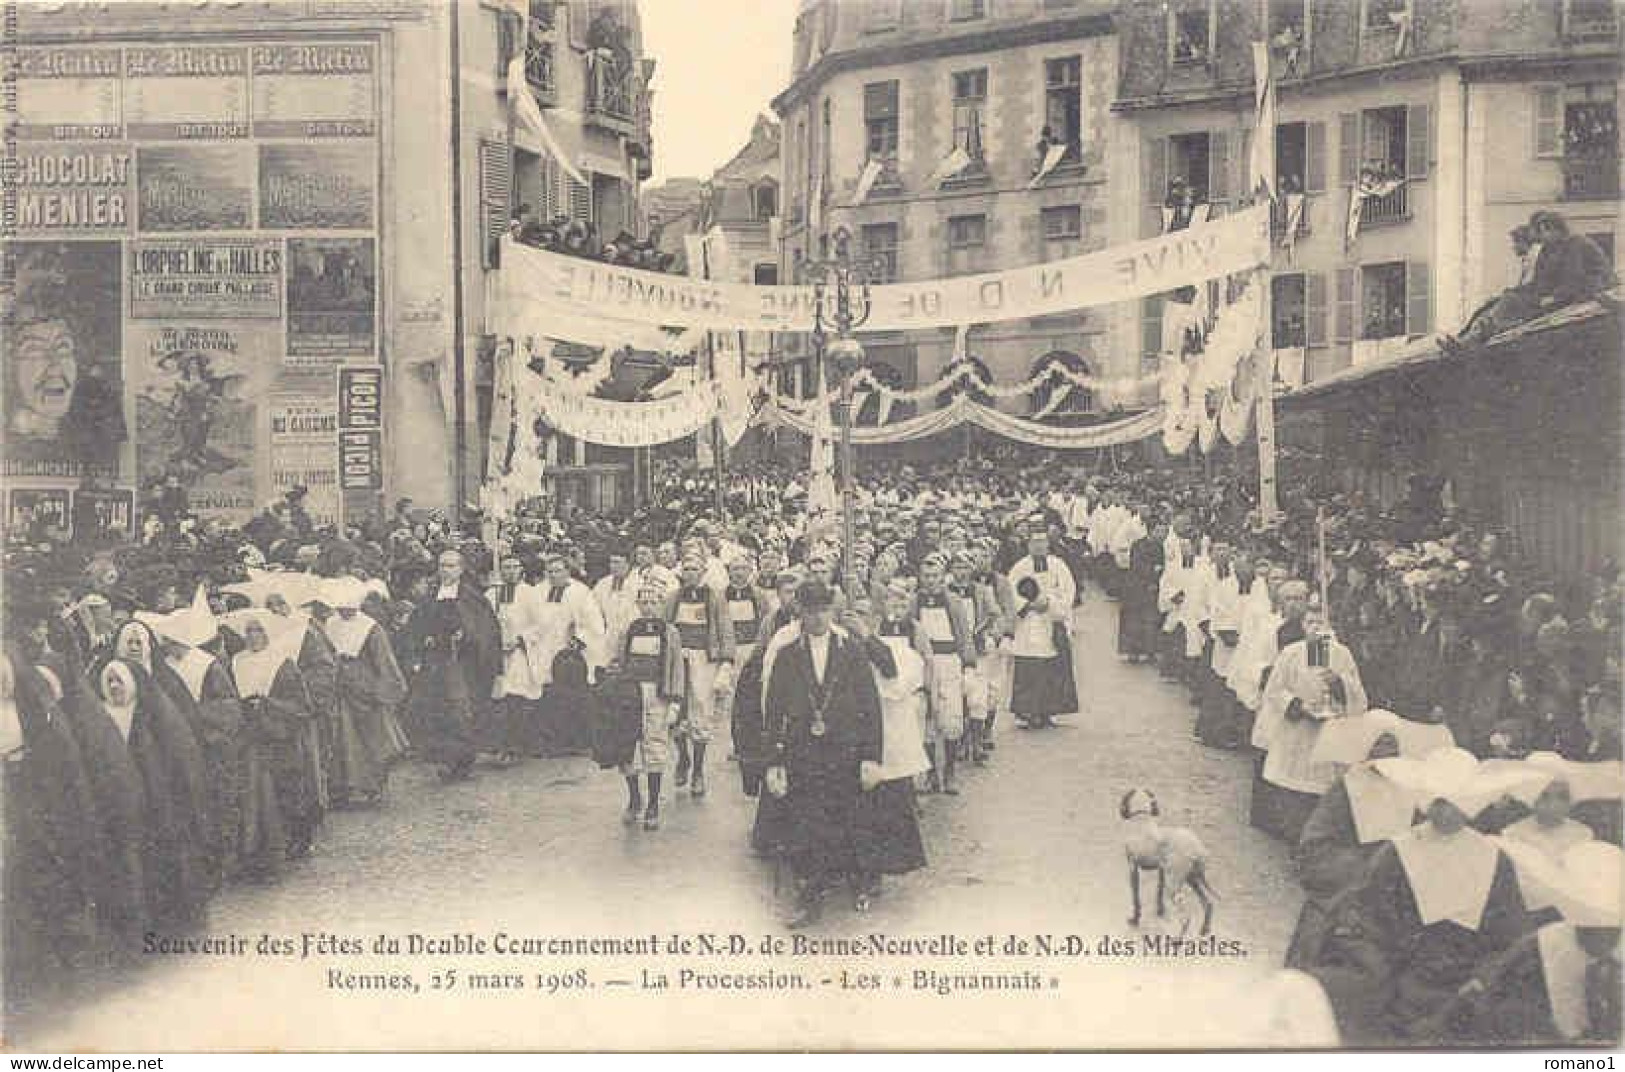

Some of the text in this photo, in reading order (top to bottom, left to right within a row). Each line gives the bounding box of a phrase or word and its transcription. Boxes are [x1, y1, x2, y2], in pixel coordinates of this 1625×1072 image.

[16, 154, 129, 186] CHOCOLAT
[18, 190, 127, 227] MENIER
[229, 248, 281, 274] HALLES
[351, 373, 379, 425] PICON
[344, 435, 371, 487] PICON
